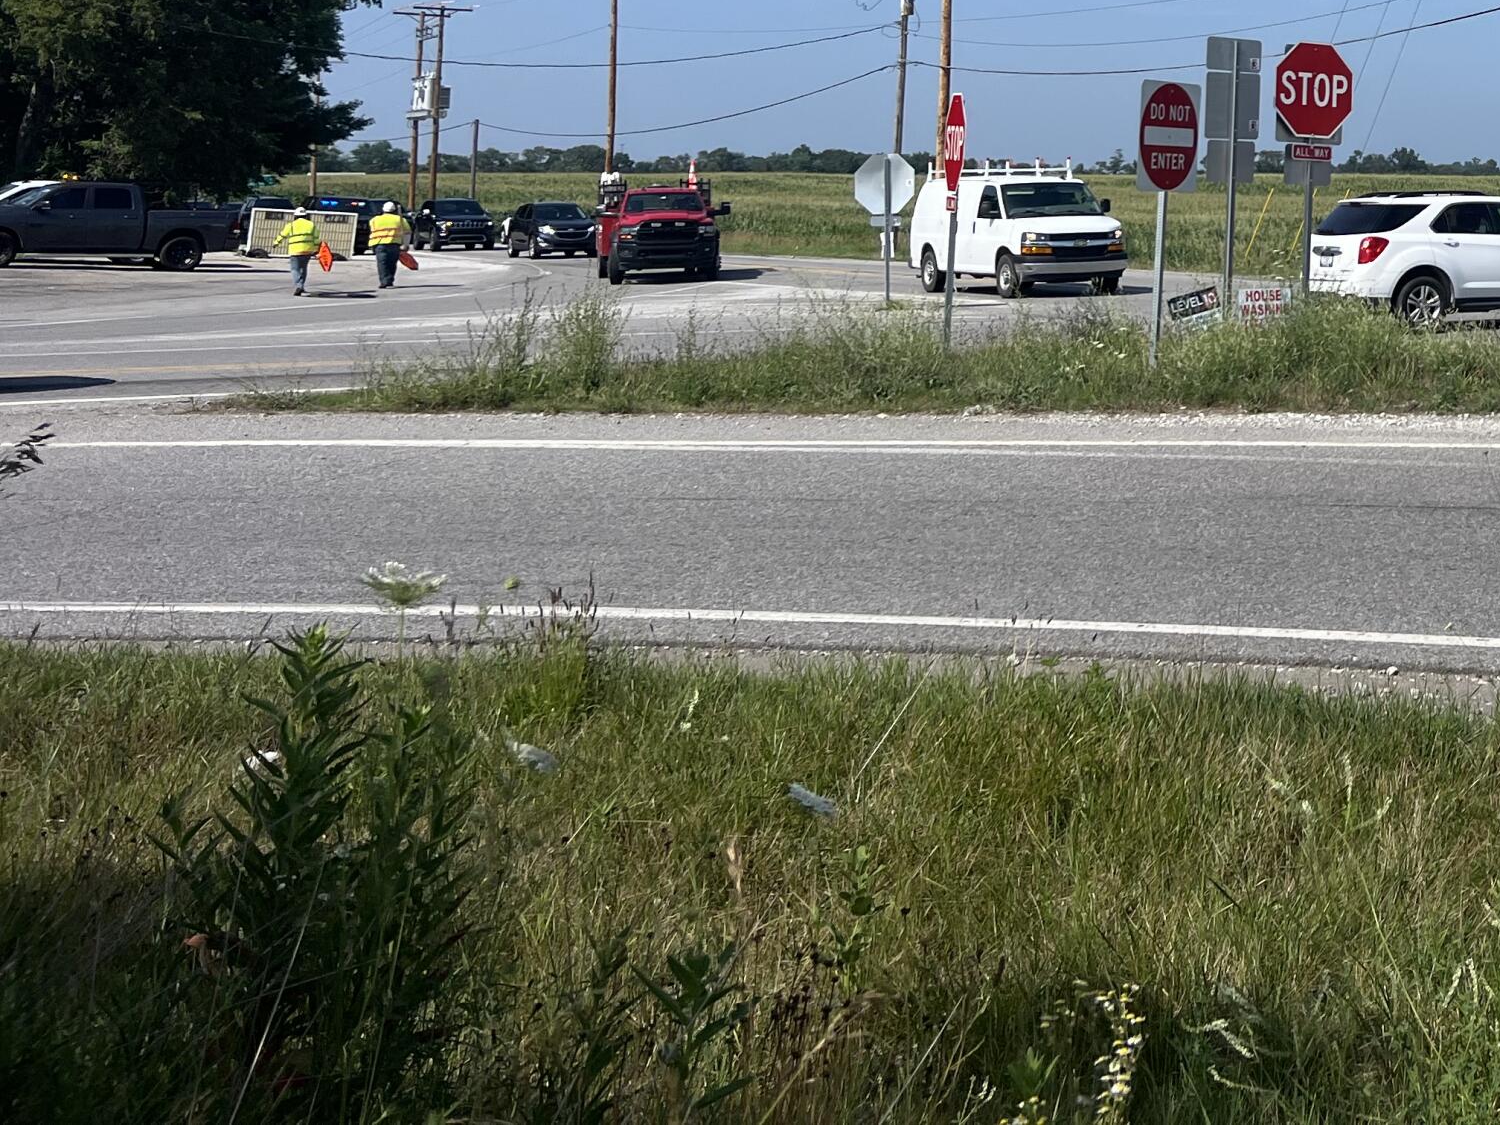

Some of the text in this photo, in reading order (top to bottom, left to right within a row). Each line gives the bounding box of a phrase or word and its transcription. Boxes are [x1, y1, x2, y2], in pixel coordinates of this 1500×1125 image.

[1280, 70, 1348, 107] STOP
[1150, 103, 1191, 122] DO NOT
[945, 125, 964, 161] STOP
[1151, 152, 1185, 170] ENTER
[1295, 147, 1330, 158] ALL WAY
[1245, 289, 1282, 303] HOUSE
